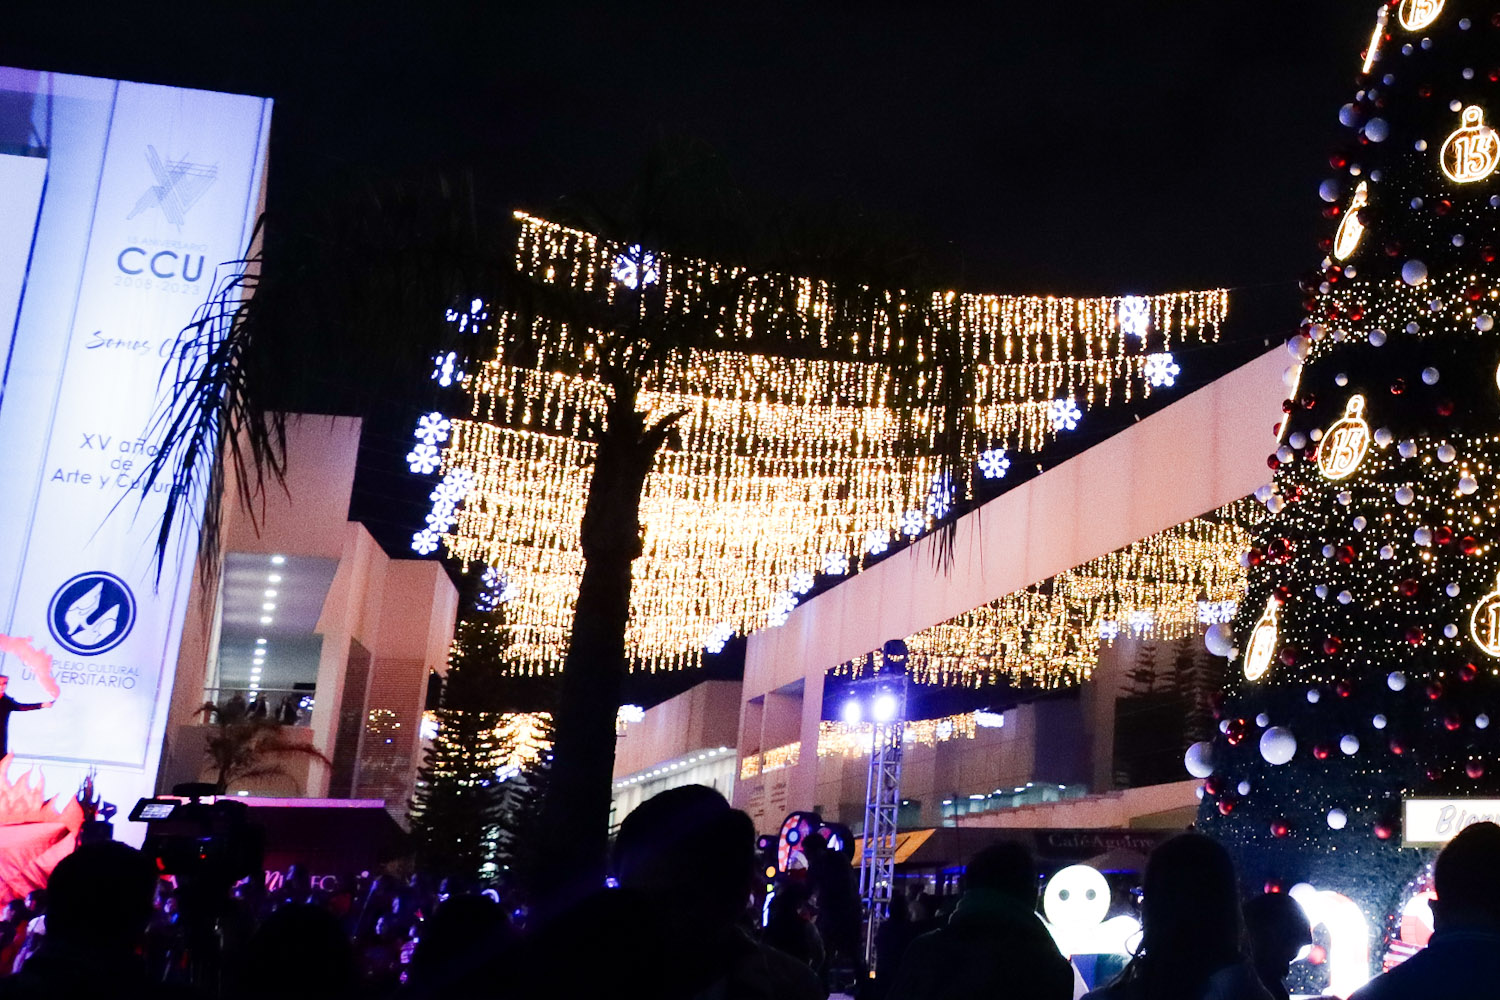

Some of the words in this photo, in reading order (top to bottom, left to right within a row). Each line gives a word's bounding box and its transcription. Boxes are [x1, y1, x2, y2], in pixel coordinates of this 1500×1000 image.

[1454, 135, 1491, 177] 15
[117, 246, 205, 282] CCU
[114, 274, 201, 296] 2008-2023
[80, 432, 112, 450] XV
[119, 437, 168, 457] año
[1327, 433, 1366, 472] 15
[111, 456, 133, 470] de
[51, 468, 92, 484] Arte
[100, 475, 110, 490] y
[21, 667, 136, 690] UVERSITARIO
[87, 662, 140, 677] CULTURAL
